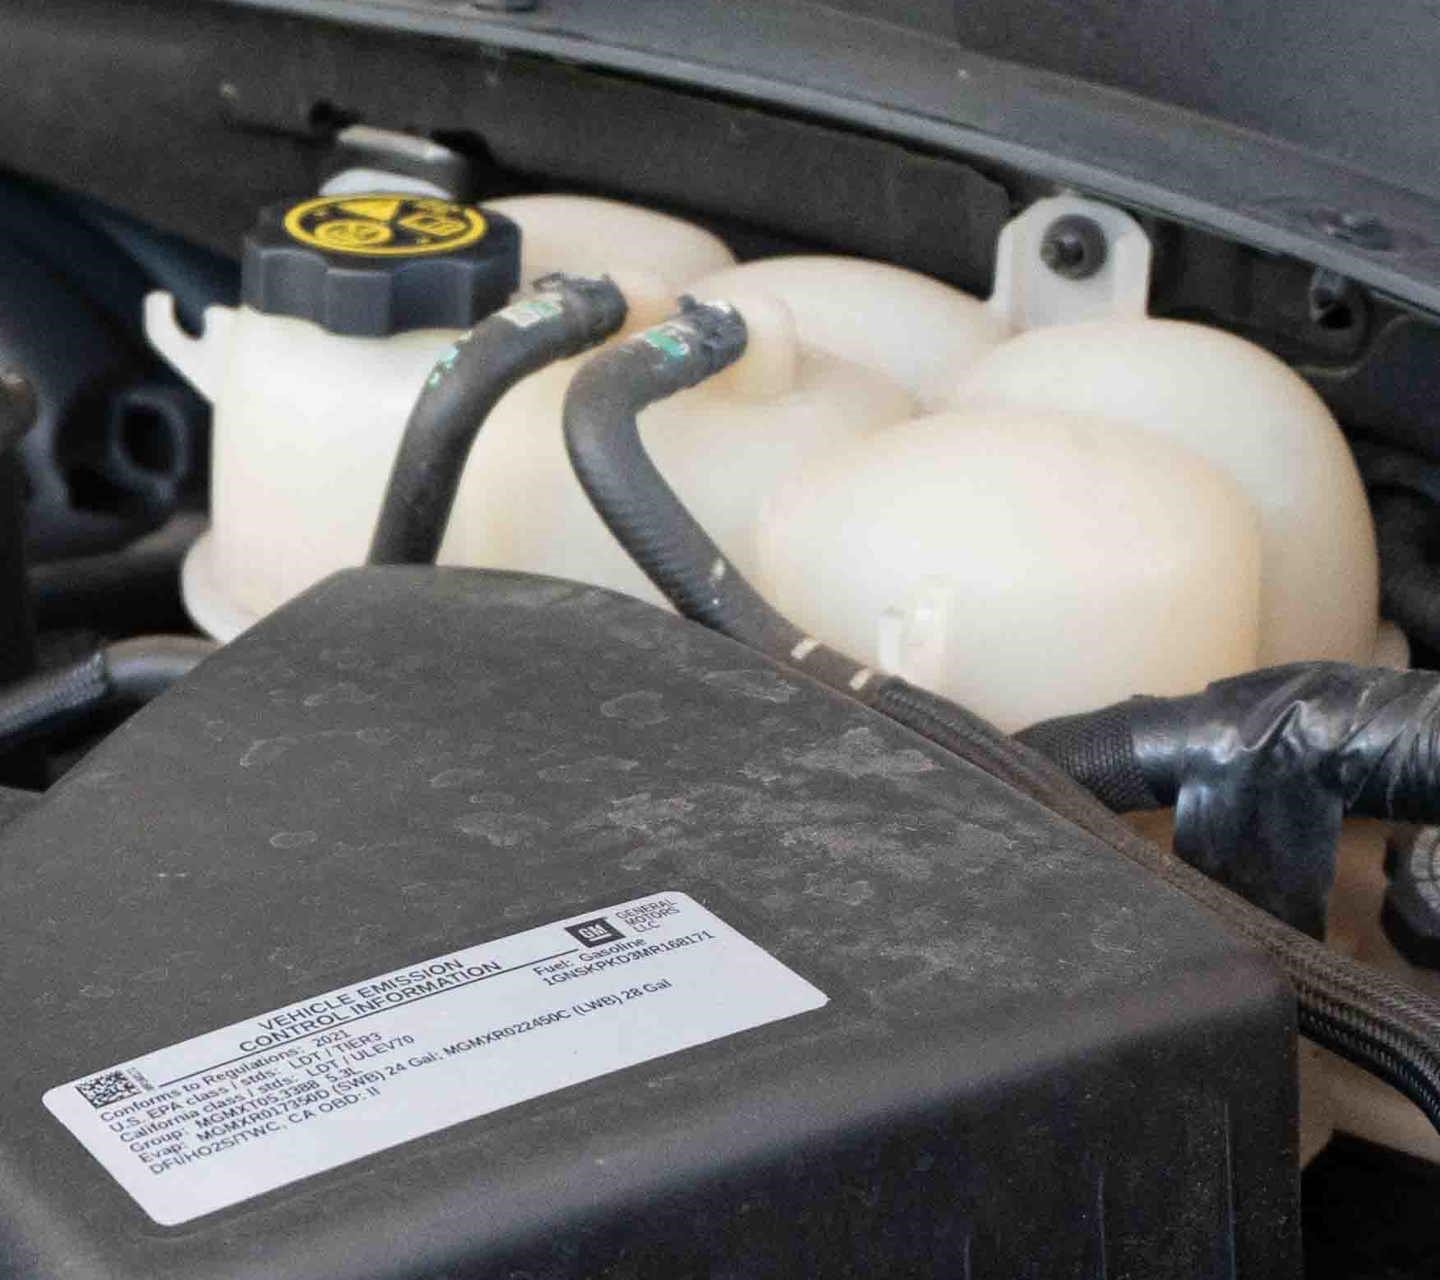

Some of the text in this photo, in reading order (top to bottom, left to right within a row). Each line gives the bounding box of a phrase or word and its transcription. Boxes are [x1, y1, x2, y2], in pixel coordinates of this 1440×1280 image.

[575, 923, 609, 939] GM
[613, 897, 678, 920] GENERAL
[623, 905, 682, 927] MOTORS
[531, 936, 649, 976] Fuel: Gasoline
[235, 959, 503, 1053] CONTROL INFORMATION
[257, 957, 465, 1031] VEHICLE EMISSION
[97, 1087, 182, 1122] Conforms
[179, 1080, 202, 1093] to
[201, 1044, 308, 1088] Regulations:
[310, 1028, 352, 1048] 2021
[107, 1114, 146, 1133] U.S.
[145, 1100, 185, 1120] EPA
[183, 1085, 230, 1107] class
[238, 1066, 283, 1087] stds:
[286, 1052, 325, 1070] LDT
[332, 1031, 384, 1054] TIER3
[117, 1108, 202, 1143] California
[200, 1092, 248, 1114] class
[255, 1074, 301, 1095] stds:
[304, 1059, 342, 1078] LDT
[349, 1034, 417, 1062] ULEV70
[136, 1139, 191, 1165] Evap:
[328, 1069, 388, 1095] (SWB)
[382, 1061, 409, 1076] 24
[569, 993, 625, 1015] (LWB)
[639, 978, 674, 993] Gal
[126, 1125, 192, 1155] Group:
[285, 1106, 320, 1124] CA
